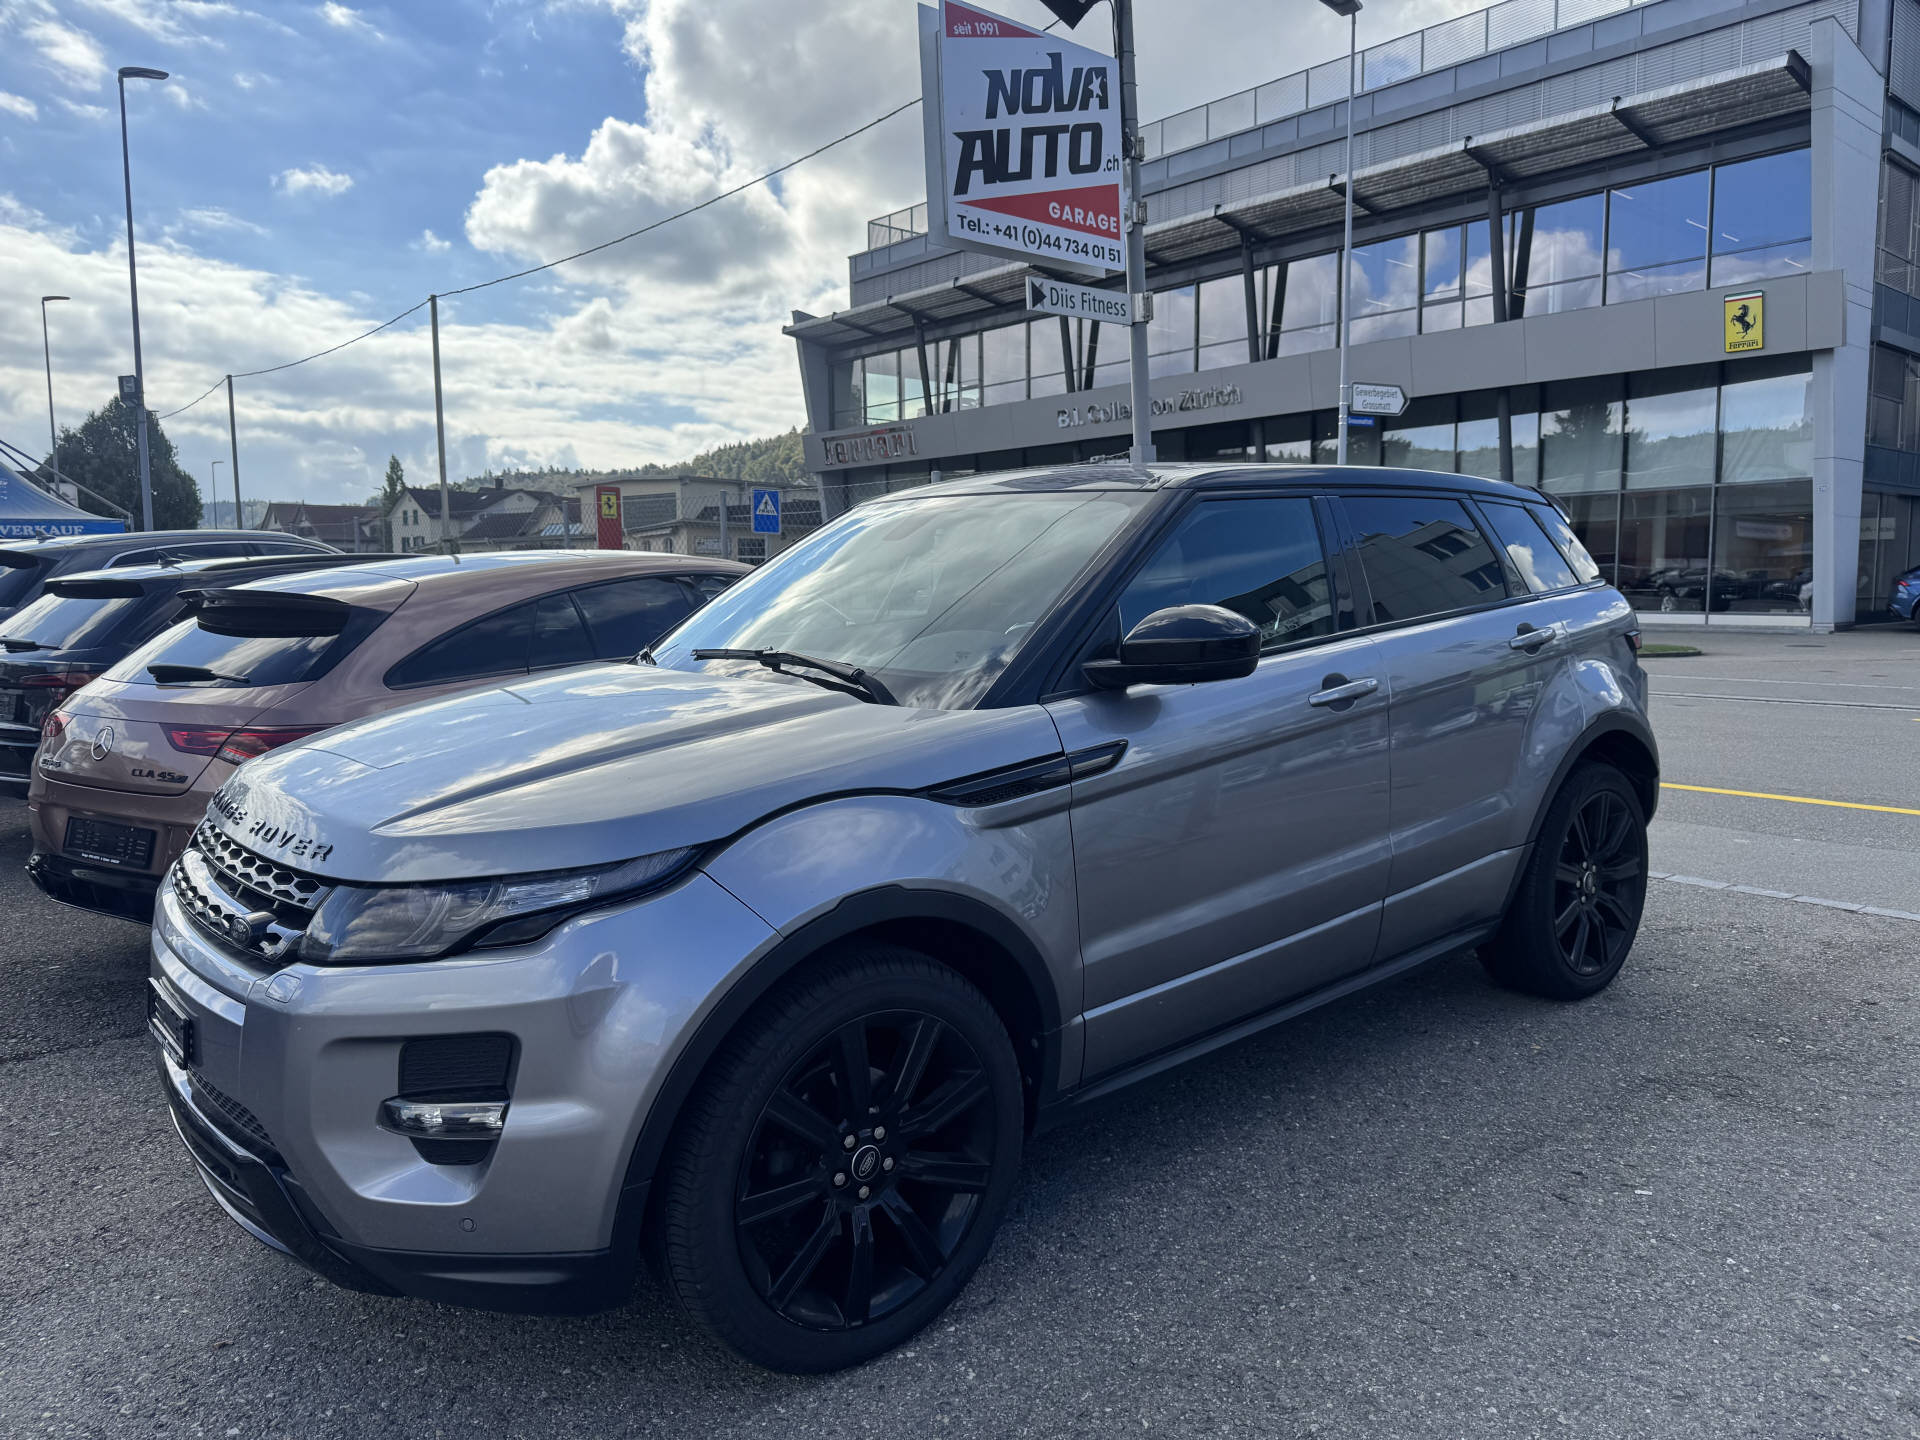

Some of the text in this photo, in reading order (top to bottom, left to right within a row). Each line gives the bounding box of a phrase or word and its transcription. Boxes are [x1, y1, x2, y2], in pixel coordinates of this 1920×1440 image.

[953, 21, 1000, 36] seit 1991
[982, 52, 1109, 119] NOVA
[952, 122, 1103, 196] AUTO
[1048, 201, 1118, 233] GARAGE
[957, 214, 1121, 263] Tel.: +41 (0)44 734 01 51
[1050, 286, 1127, 318] Diis Fitness
[1729, 339, 1759, 350] Ferrari
[1179, 383, 1242, 412] Zürich
[822, 424, 919, 466] Ferrari
[0, 524, 84, 536] VERKAUF
[131, 768, 155, 778] CLA
[248, 818, 333, 861] ROVER
